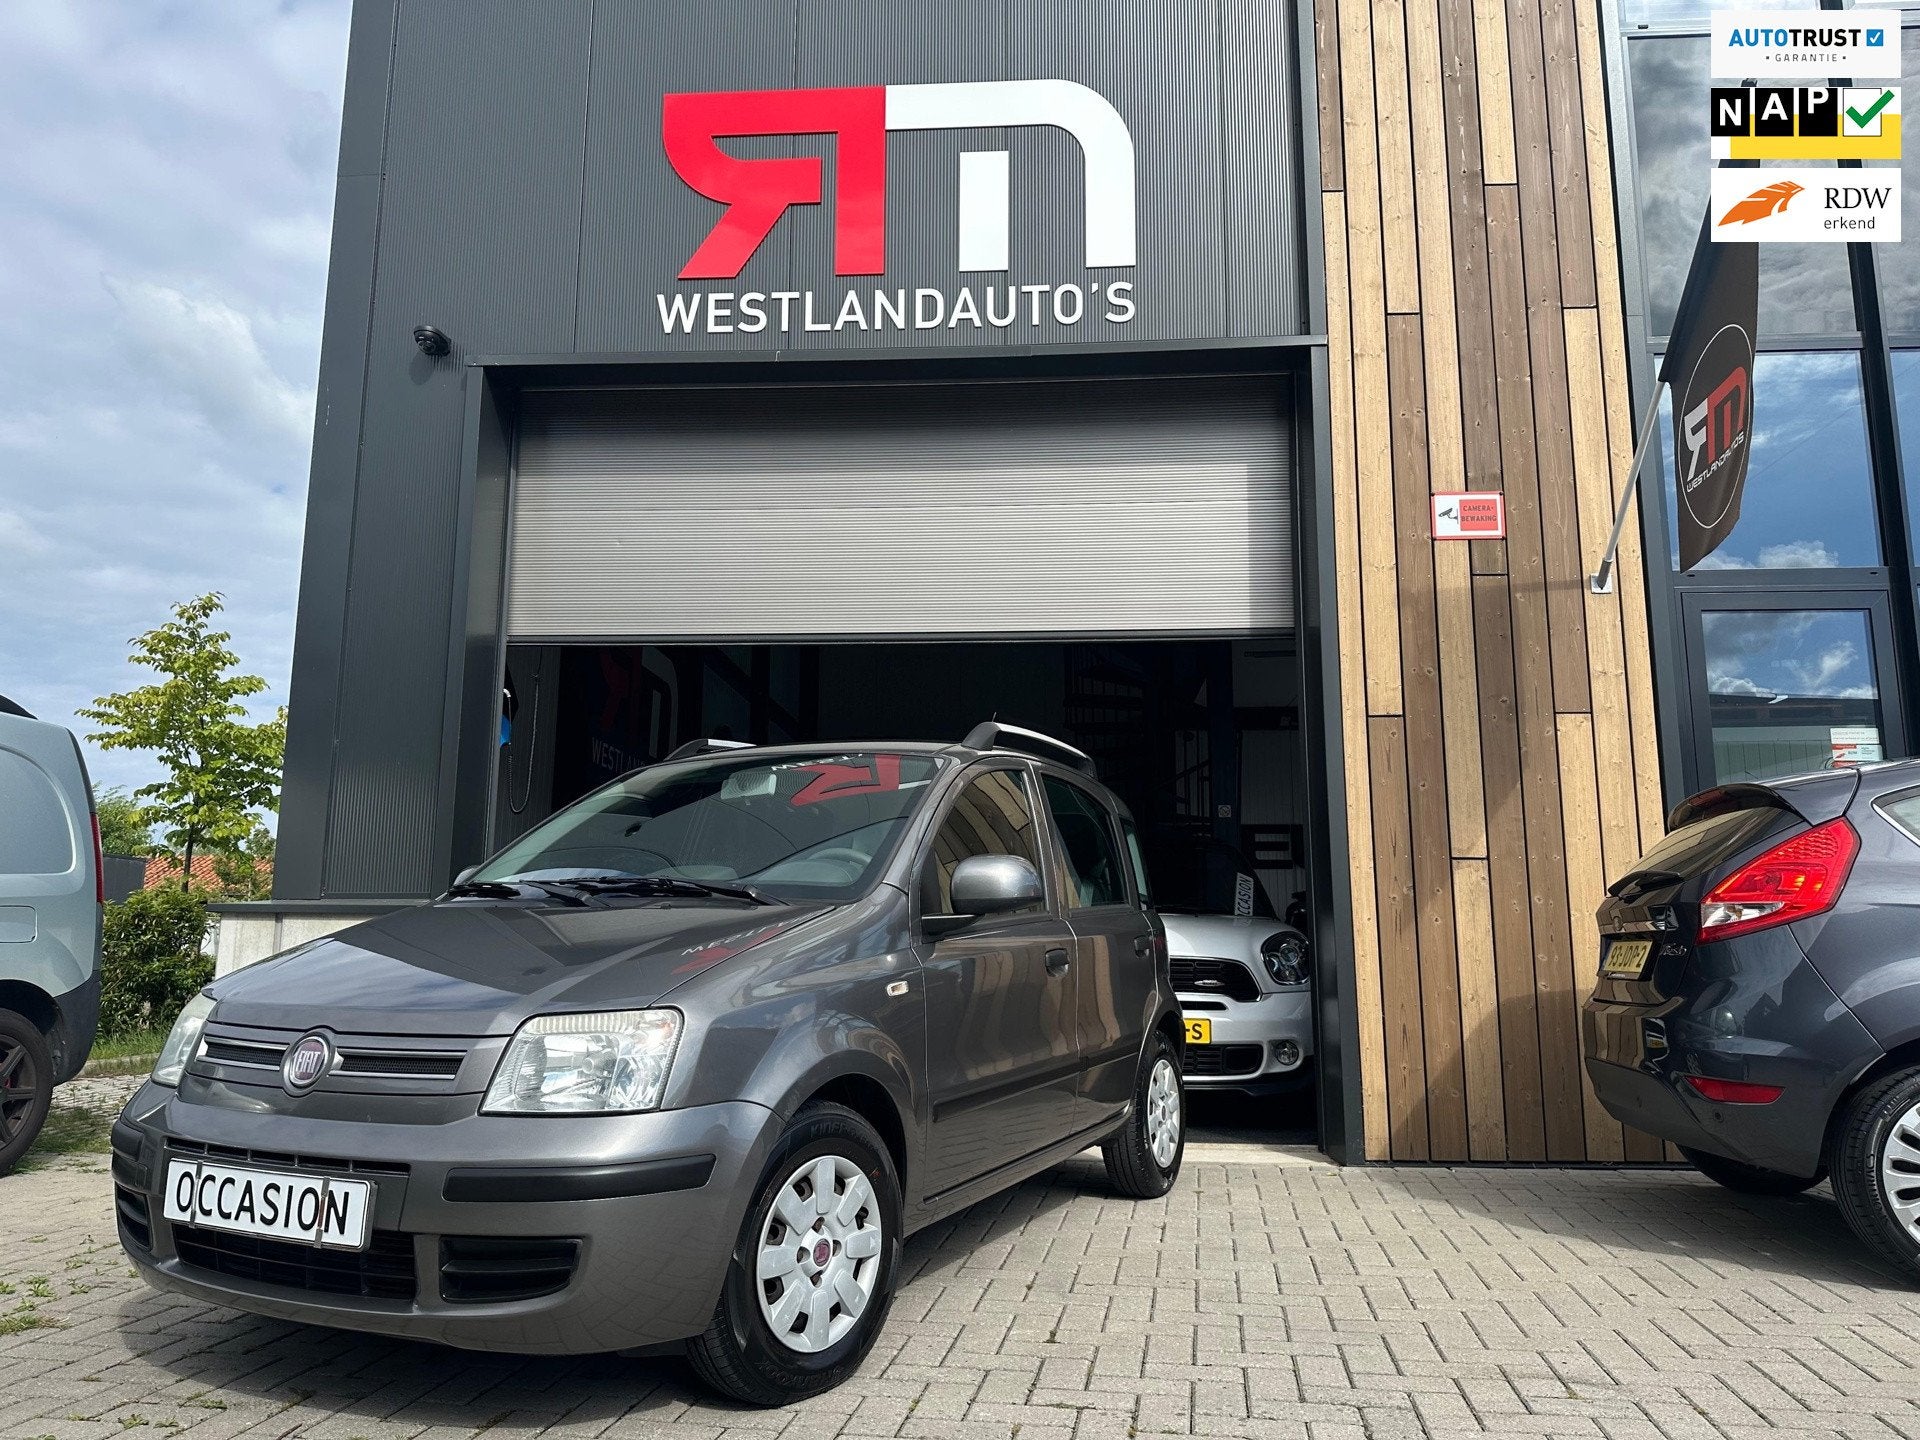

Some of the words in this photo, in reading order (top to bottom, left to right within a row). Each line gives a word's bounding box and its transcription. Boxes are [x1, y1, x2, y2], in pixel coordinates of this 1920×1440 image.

[656, 281, 1137, 334] WESTLANDAUTO'S
[1237, 876, 1252, 915] CCASION
[295, 1050, 321, 1074] FIAT
[176, 1171, 350, 1235] OCCASION
